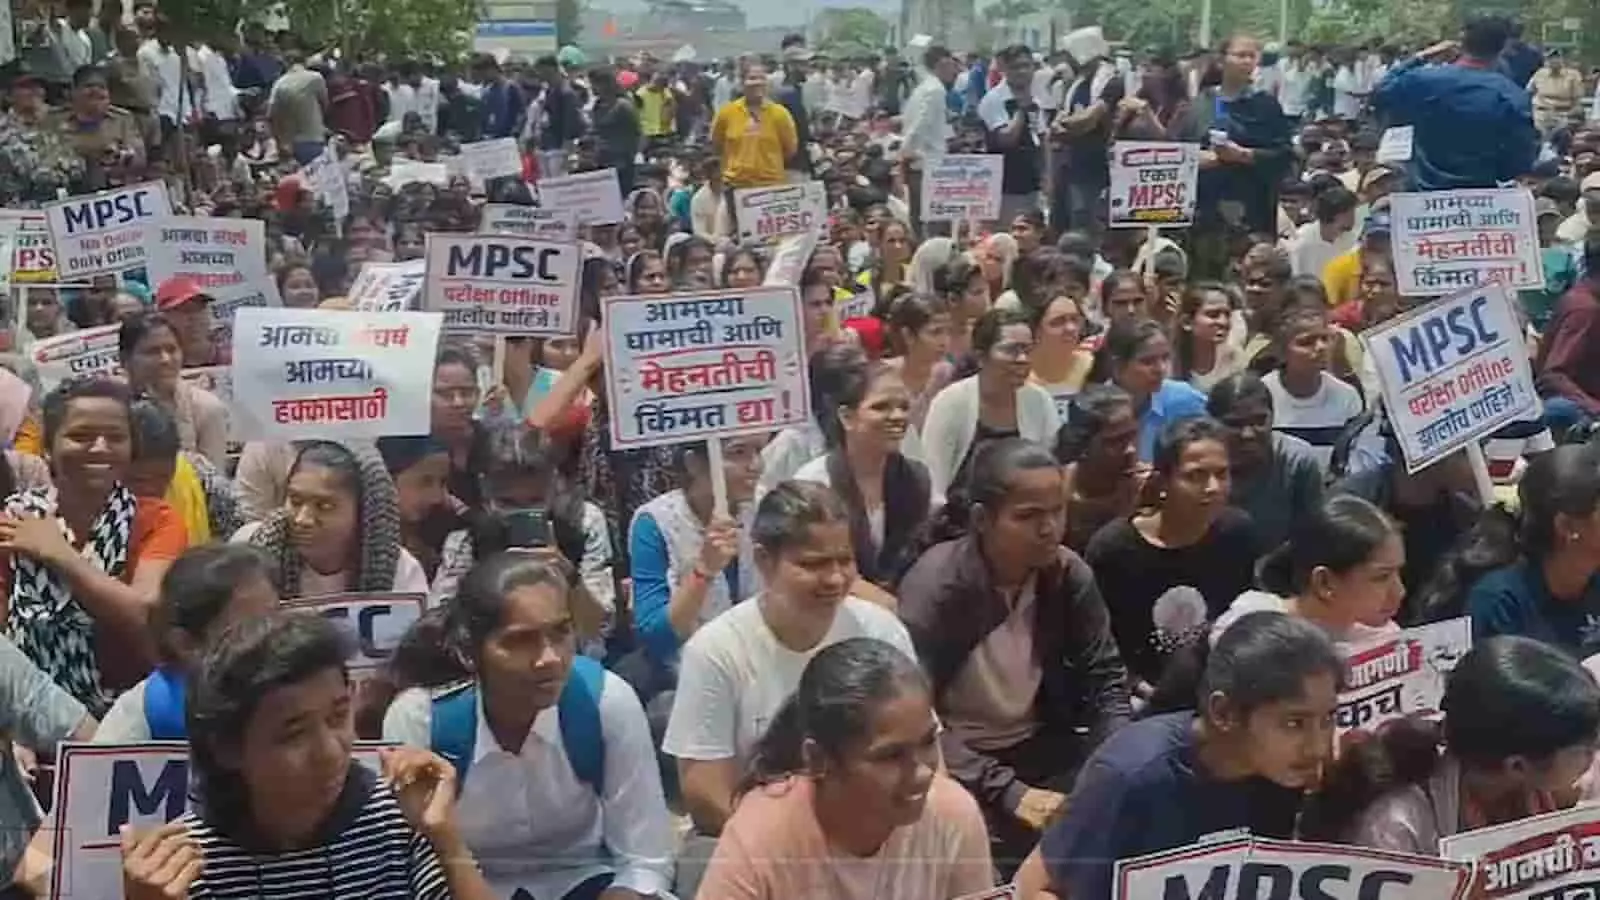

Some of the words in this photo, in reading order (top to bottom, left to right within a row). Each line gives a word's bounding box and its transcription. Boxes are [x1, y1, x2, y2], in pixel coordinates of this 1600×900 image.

[63, 191, 153, 233] MPSC
[1128, 183, 1187, 208] MPSC
[757, 211, 813, 235] MPSC
[18, 247, 54, 268] PS
[447, 244, 561, 281] MPSC
[646, 297, 745, 323] आमच्या
[624, 320, 714, 351] घामाची
[722, 316, 784, 343] आणि
[1388, 296, 1499, 382] MPSC
[285, 358, 373, 384] आमच्या
[638, 351, 777, 393] मेहनतीची
[1458, 356, 1515, 395] Offline
[271, 386, 389, 425] हक्कासाठी
[634, 400, 727, 436] किंमत
[735, 398, 776, 424] द्या
[782, 390, 792, 419] !
[1335, 684, 1404, 727] कच
[1484, 833, 1578, 891] आमची
